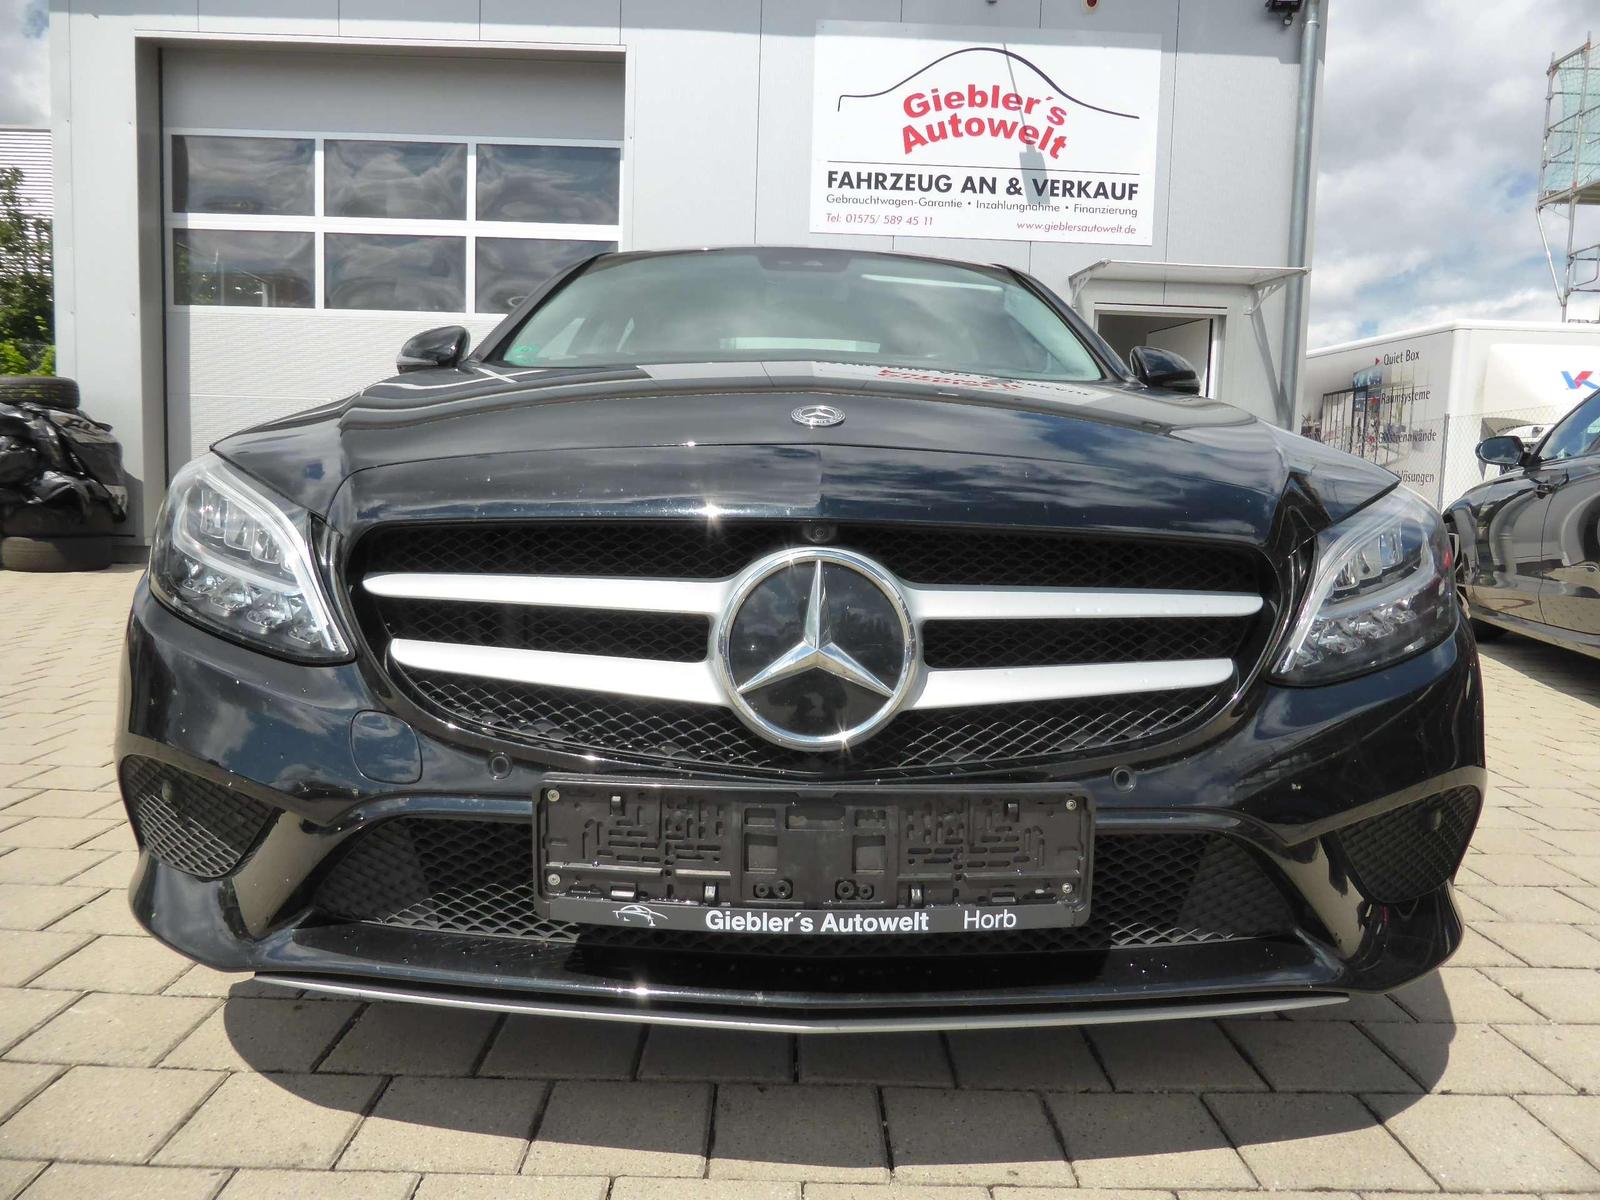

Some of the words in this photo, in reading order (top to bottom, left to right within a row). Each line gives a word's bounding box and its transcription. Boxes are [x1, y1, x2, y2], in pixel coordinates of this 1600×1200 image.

[902, 113, 1067, 159] Autowelt
[827, 170, 953, 193] FAHRZEUG
[960, 175, 997, 195] AN
[1005, 177, 1023, 196] &
[1032, 178, 1139, 201] VERKAUF
[826, 193, 963, 208] Gebrauchtwagen-Garantie
[976, 200, 1060, 213] Inzahlungnahme
[1073, 203, 1138, 218] Finanzierung
[883, 214, 903, 225] 589
[906, 215, 919, 226] 45
[924, 216, 933, 226] 11
[1016, 221, 1136, 235] www.gieblersautowelt.de
[1383, 351, 1403, 366] Quiet
[1405, 349, 1420, 362] Box
[820, 911, 929, 933] Autowelt
[963, 908, 1017, 930] Horb
